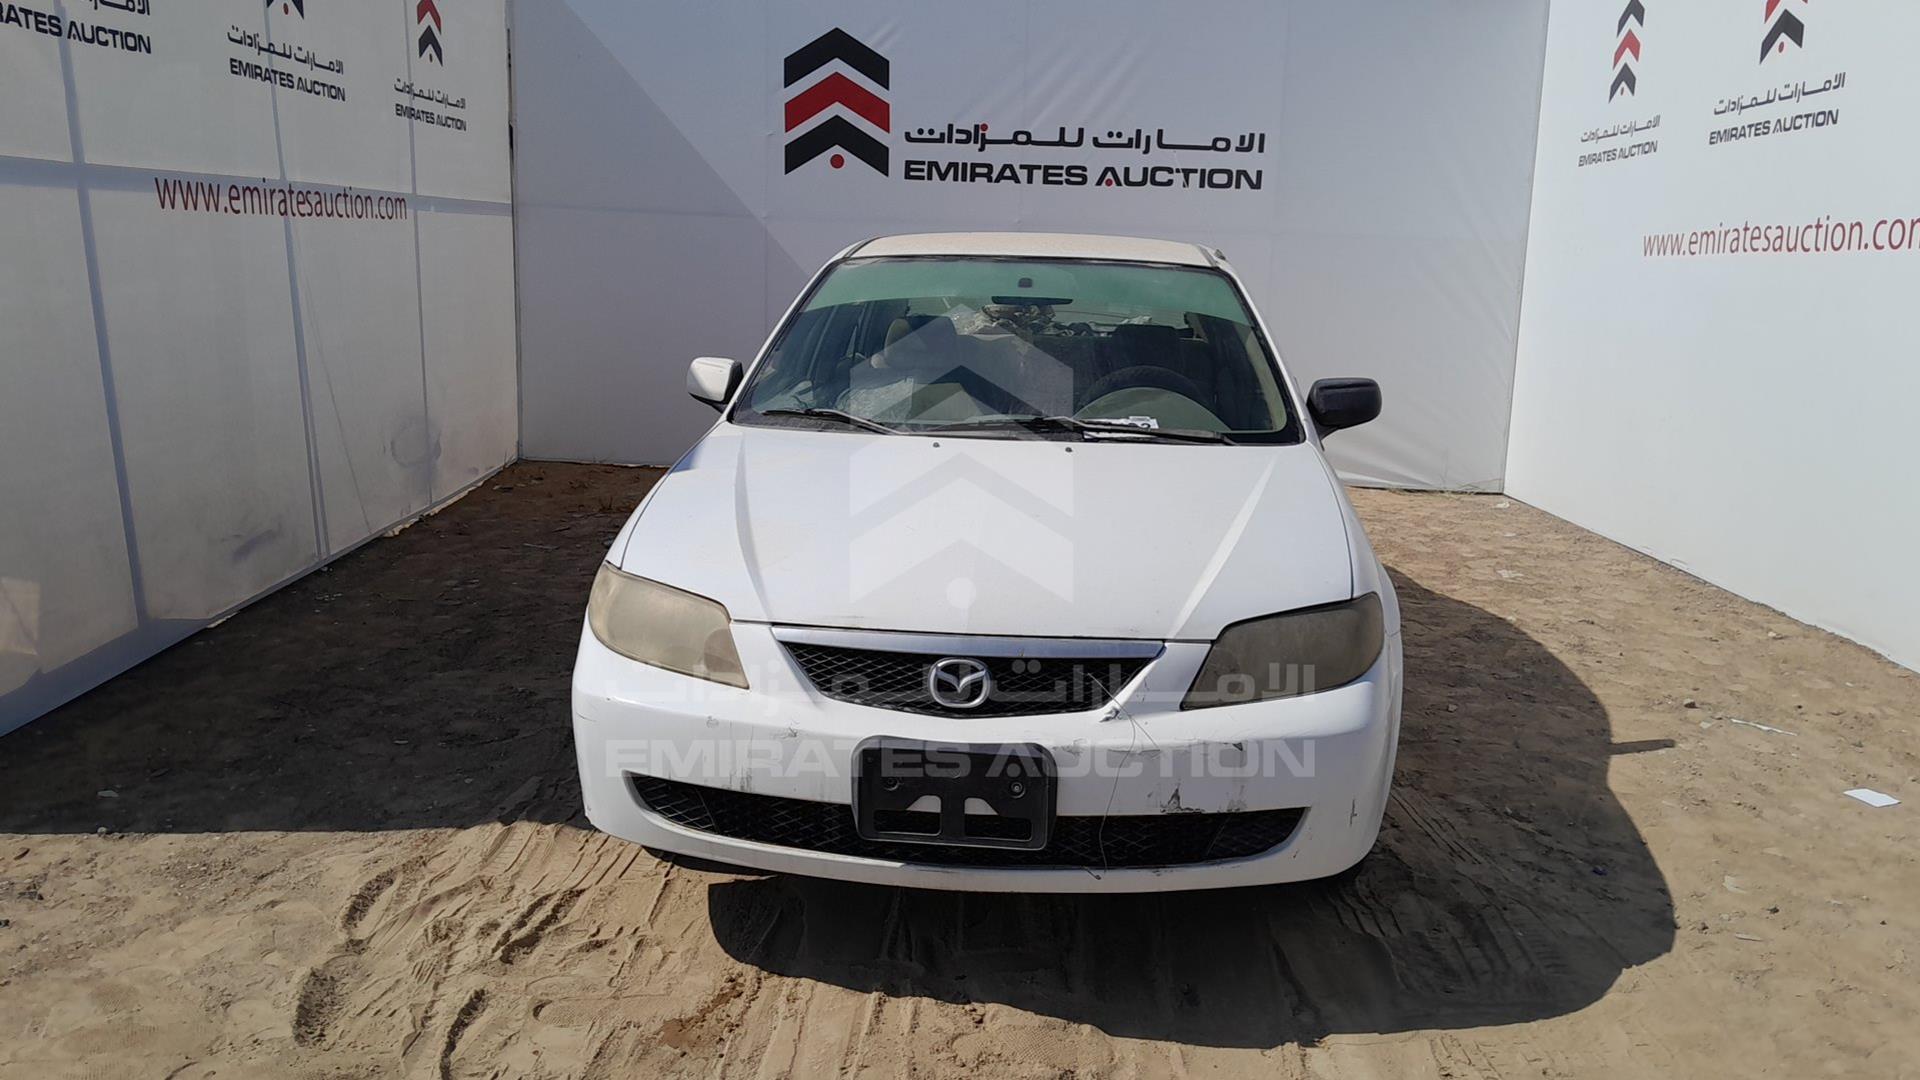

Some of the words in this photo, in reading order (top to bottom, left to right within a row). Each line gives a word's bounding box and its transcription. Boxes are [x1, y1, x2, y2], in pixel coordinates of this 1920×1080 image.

[67, 20, 151, 54] AUCTION
[229, 57, 295, 89] EMIRATES
[296, 76, 346, 102] AUCTION
[395, 103, 435, 125] EMIRATES
[436, 114, 467, 131] AUCTION
[1709, 119, 1771, 145] EMIRATES
[1772, 109, 1840, 134] AUCTION
[1578, 148, 1618, 167] EMIRATES
[1617, 140, 1659, 160] AUCTION
[903, 159, 1089, 186] EMIRATES
[1095, 165, 1264, 190] AUCTION
[154, 176, 408, 220] www.emiratesauction.com
